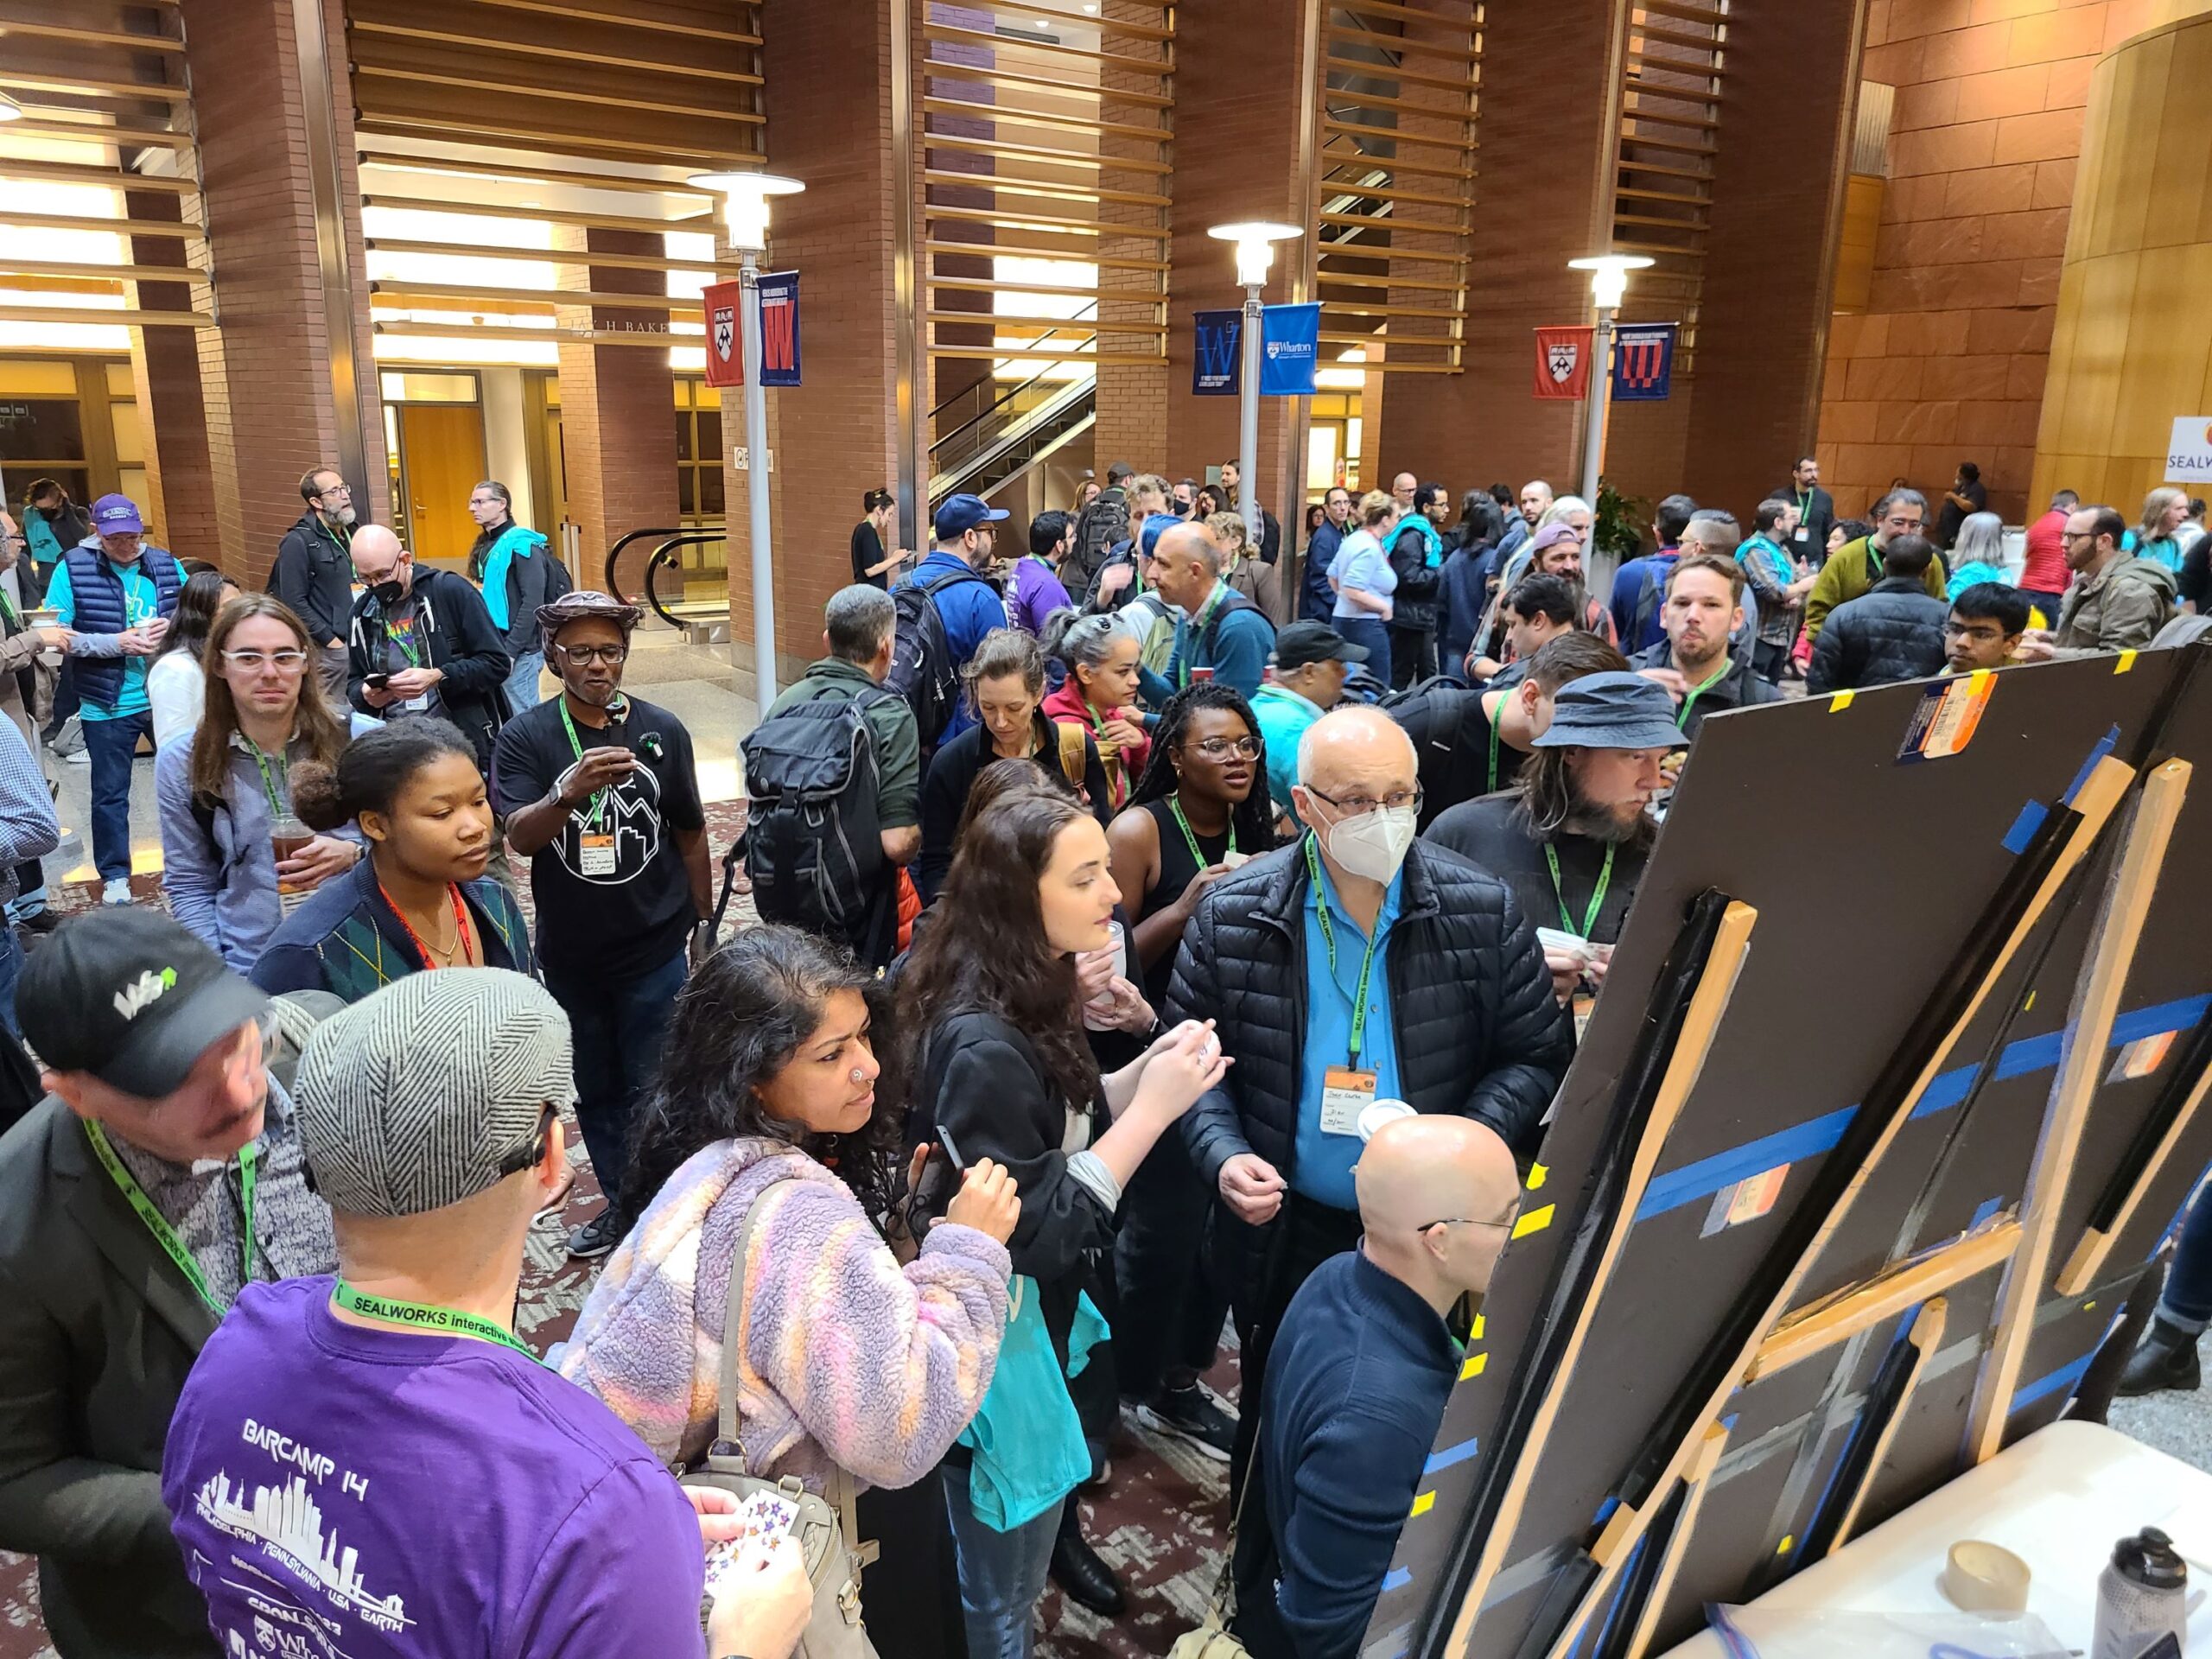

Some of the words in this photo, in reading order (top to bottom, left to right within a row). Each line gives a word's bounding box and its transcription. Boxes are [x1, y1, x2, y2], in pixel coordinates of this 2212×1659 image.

[606, 321, 616, 332] H
[1279, 341, 1312, 353] Wharton
[1354, 988, 1368, 1032] SEALWORKS
[353, 1296, 448, 1325] SEALWORKS
[449, 1313, 508, 1342] interactive
[241, 1418, 336, 1486] BARCAMP
[341, 1471, 370, 1502] 14
[195, 1502, 257, 1545] PHILADELPHIA
[261, 1541, 321, 1592] PENNSYLVANIA
[327, 1588, 350, 1611] USA
[359, 1606, 405, 1634] EARTH
